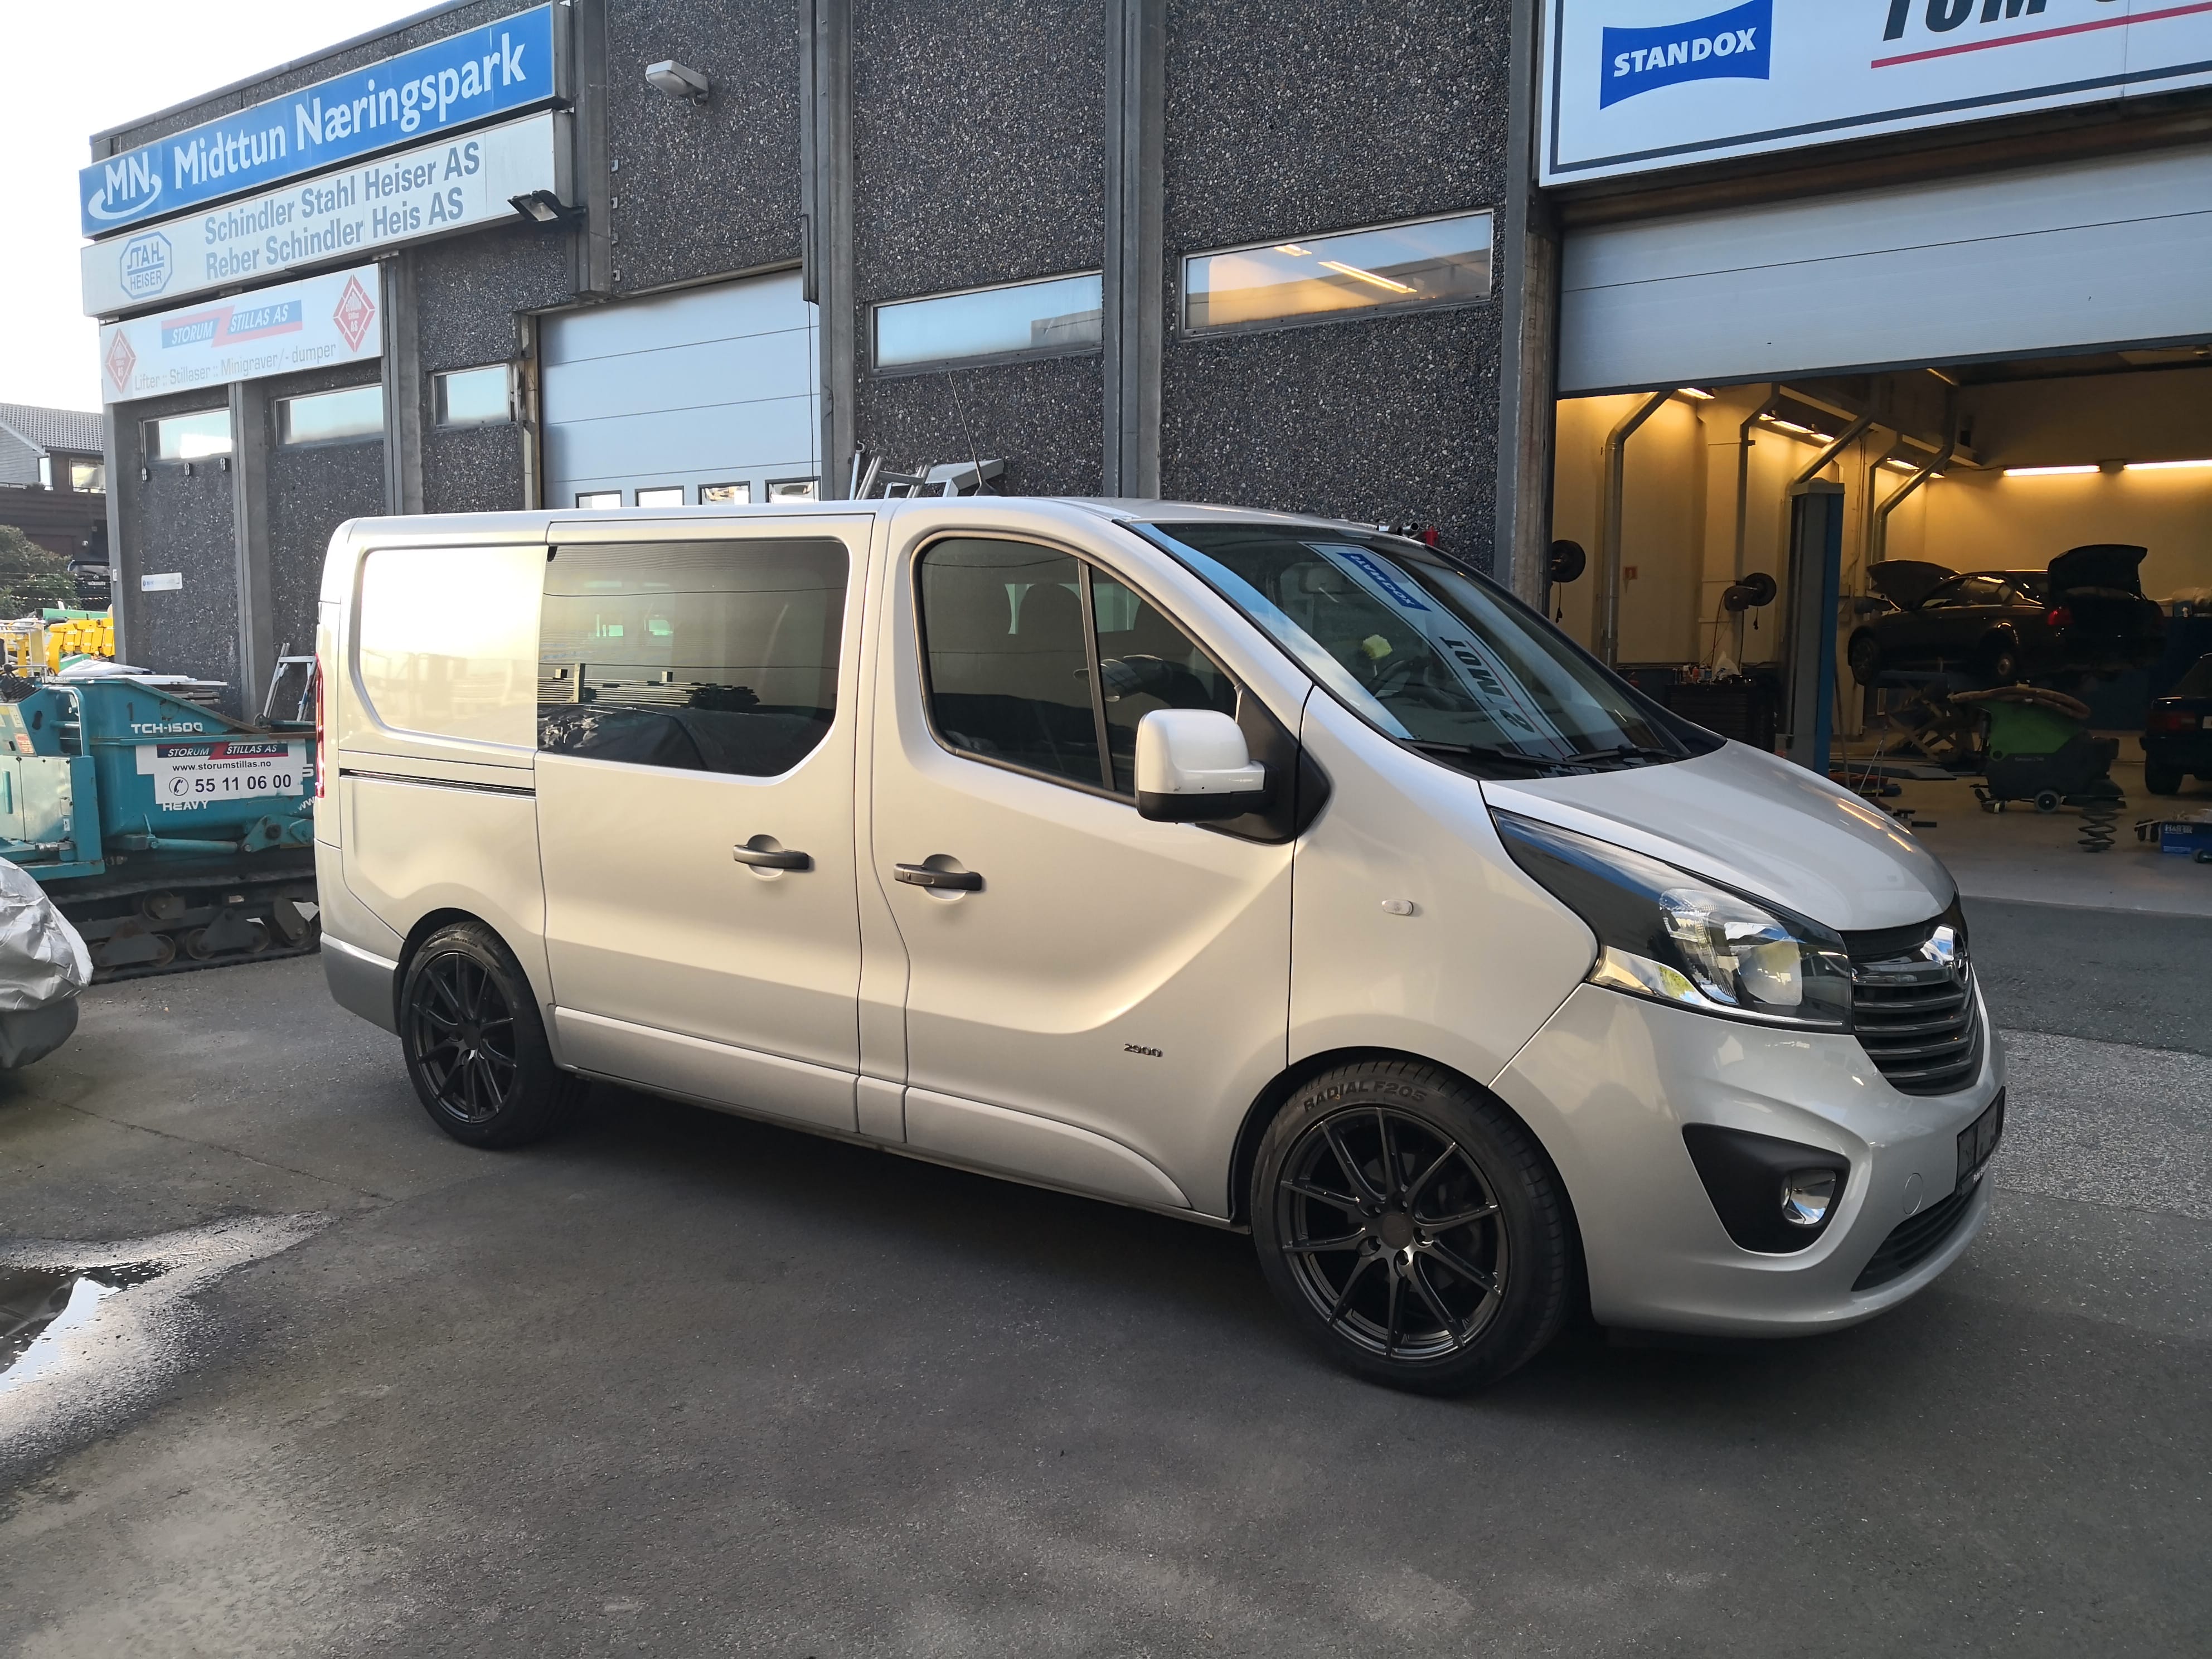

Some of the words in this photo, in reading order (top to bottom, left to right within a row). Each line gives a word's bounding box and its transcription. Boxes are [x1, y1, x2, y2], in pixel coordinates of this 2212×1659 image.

[1613, 27, 1757, 77] STANDOX
[174, 125, 287, 191] Midttun
[295, 32, 527, 147] Næringspark
[105, 151, 150, 205] MN
[205, 198, 295, 245] Schindler
[301, 175, 356, 219] Stahl
[365, 162, 436, 201] Heiser
[443, 141, 480, 181] AS
[206, 247, 260, 280] Reber
[265, 217, 363, 265] Schindler
[372, 200, 421, 239] Heis
[428, 187, 464, 226] AS
[130, 270, 163, 291] HEISER
[172, 321, 214, 345] STORUM
[230, 308, 271, 333] STILLAS
[273, 304, 289, 324] AS
[135, 374, 161, 391] Lifter
[169, 367, 211, 385] Stillaser
[292, 343, 336, 364] dumper
[130, 722, 203, 734] TCH-1500
[167, 748, 210, 758] STORUM
[226, 745, 262, 754] STILLAS
[264, 745, 277, 753] AS
[172, 761, 271, 772] www.storumstillas.no
[195, 779, 215, 793] 55
[222, 777, 239, 791] 11
[247, 775, 267, 790] 06
[273, 774, 292, 788] 00
[162, 801, 208, 812] HEAVY
[1303, 1080, 1369, 1112] RADIAL
